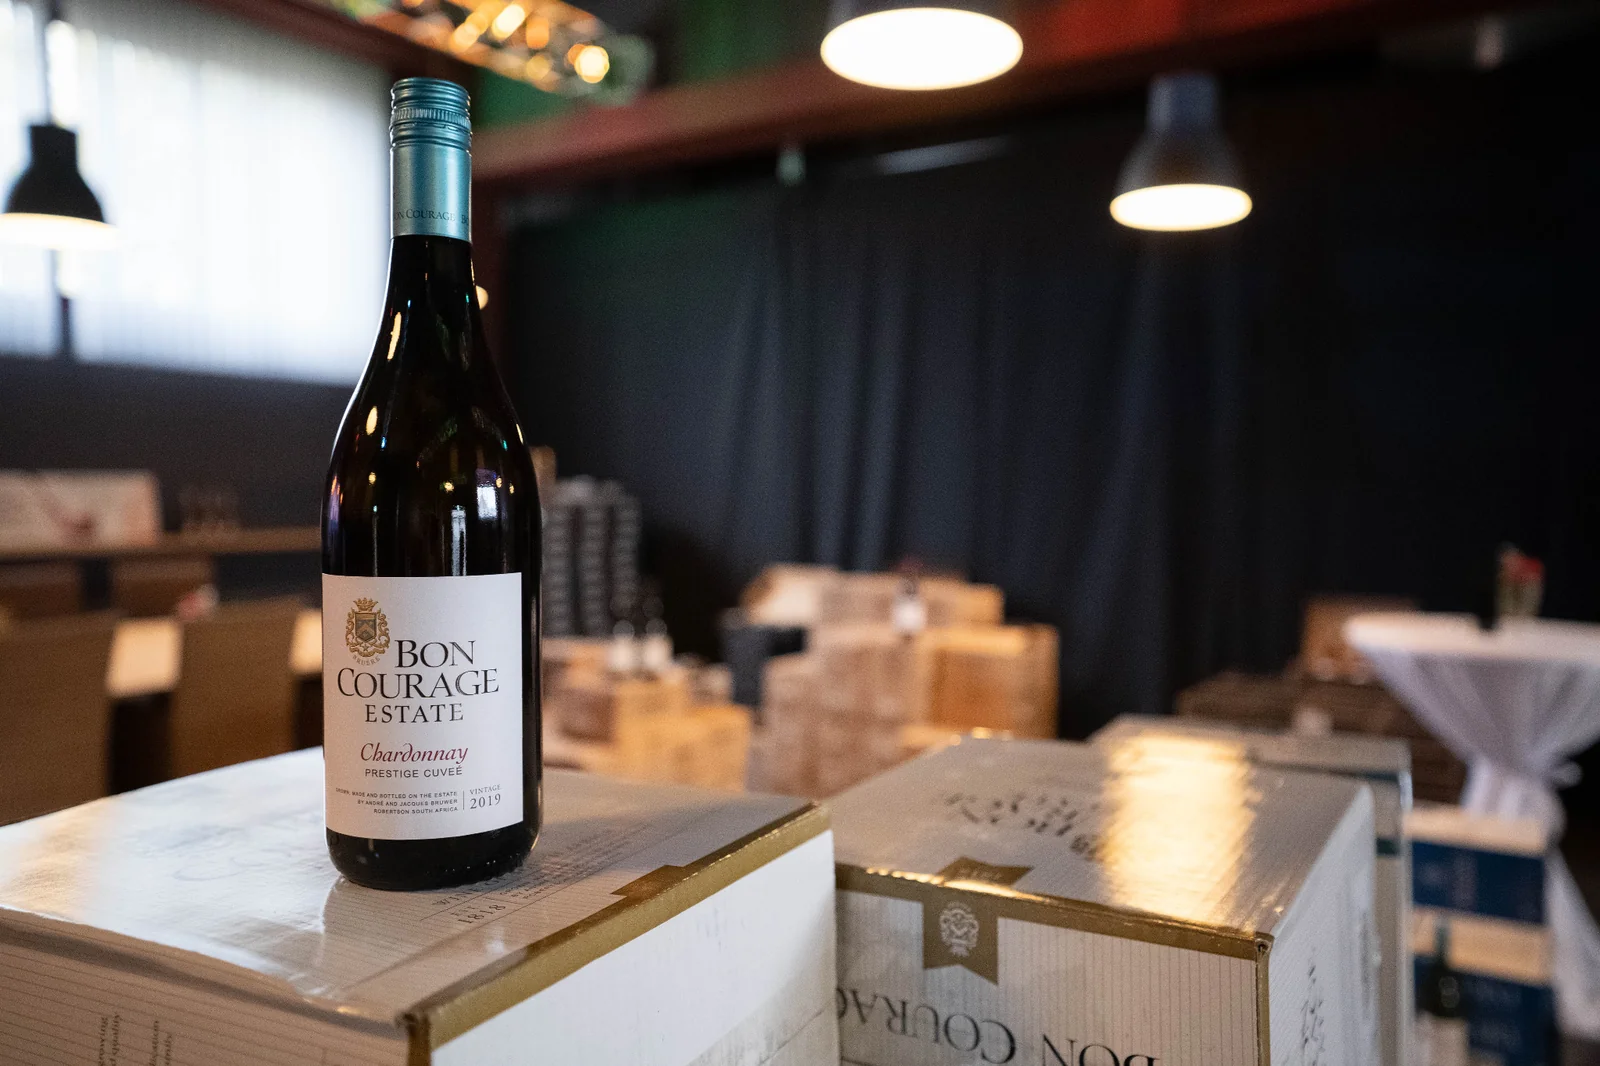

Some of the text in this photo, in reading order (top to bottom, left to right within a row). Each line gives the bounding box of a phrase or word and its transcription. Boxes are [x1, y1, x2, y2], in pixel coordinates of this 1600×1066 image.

[394, 639, 476, 669] BON
[337, 667, 500, 700] COURAGE
[365, 703, 464, 724] ESTATE
[360, 742, 469, 765] Chardonnay
[365, 768, 419, 779] PRESTIGE
[469, 783, 501, 795] VINTAGE
[469, 793, 501, 810] 2019
